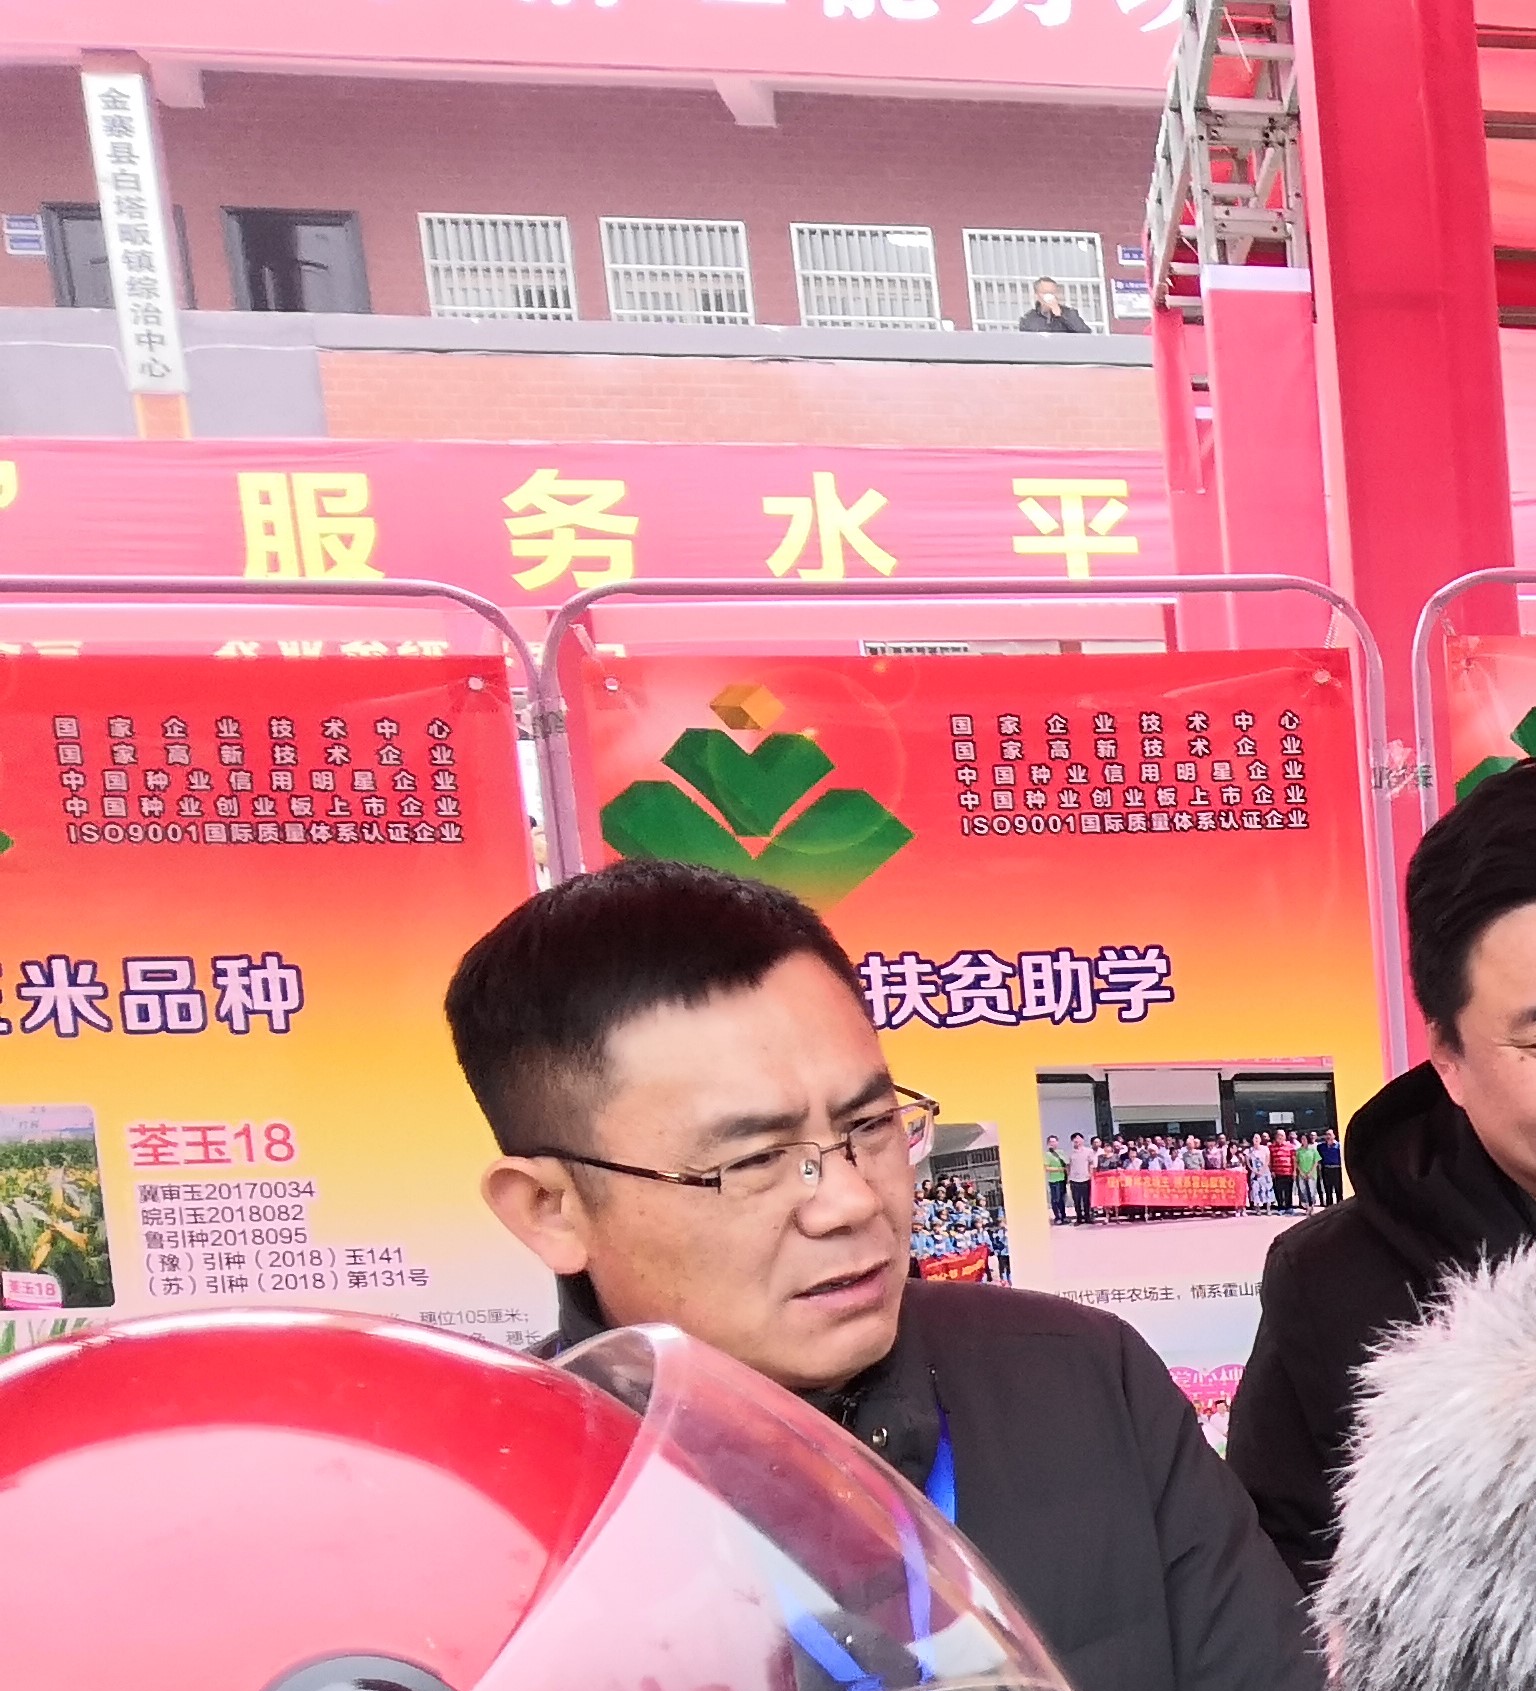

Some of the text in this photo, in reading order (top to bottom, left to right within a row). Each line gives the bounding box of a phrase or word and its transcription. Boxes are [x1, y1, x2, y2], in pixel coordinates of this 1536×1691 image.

[0, 462, 1140, 592] 服务水平
[53, 716, 451, 741] 国家企业技术中心
[951, 713, 1300, 737] 国家企业技术中心
[57, 743, 456, 768] 国家高新技术企业
[953, 735, 1304, 762] 国家高新技术企业
[61, 771, 458, 793] 中国种业信用明星企业
[956, 760, 1305, 786] 中国种业信用明星企业
[65, 796, 461, 819] 中国种业创业板上市企业
[959, 784, 1306, 811] 中国种业创业板上市企业
[67, 823, 464, 847] ISO9001国际质量体系认证企业
[961, 809, 1309, 836] ISO9001国际质量体系认证企业
[0, 952, 305, 1037] 米品种
[860, 945, 1175, 1028] 扶贫助学
[128, 1123, 296, 1168] 荃玉18
[142, 1204, 305, 1226] 皖引玉2018082
[144, 1227, 308, 1249] 鲁引种2018095
